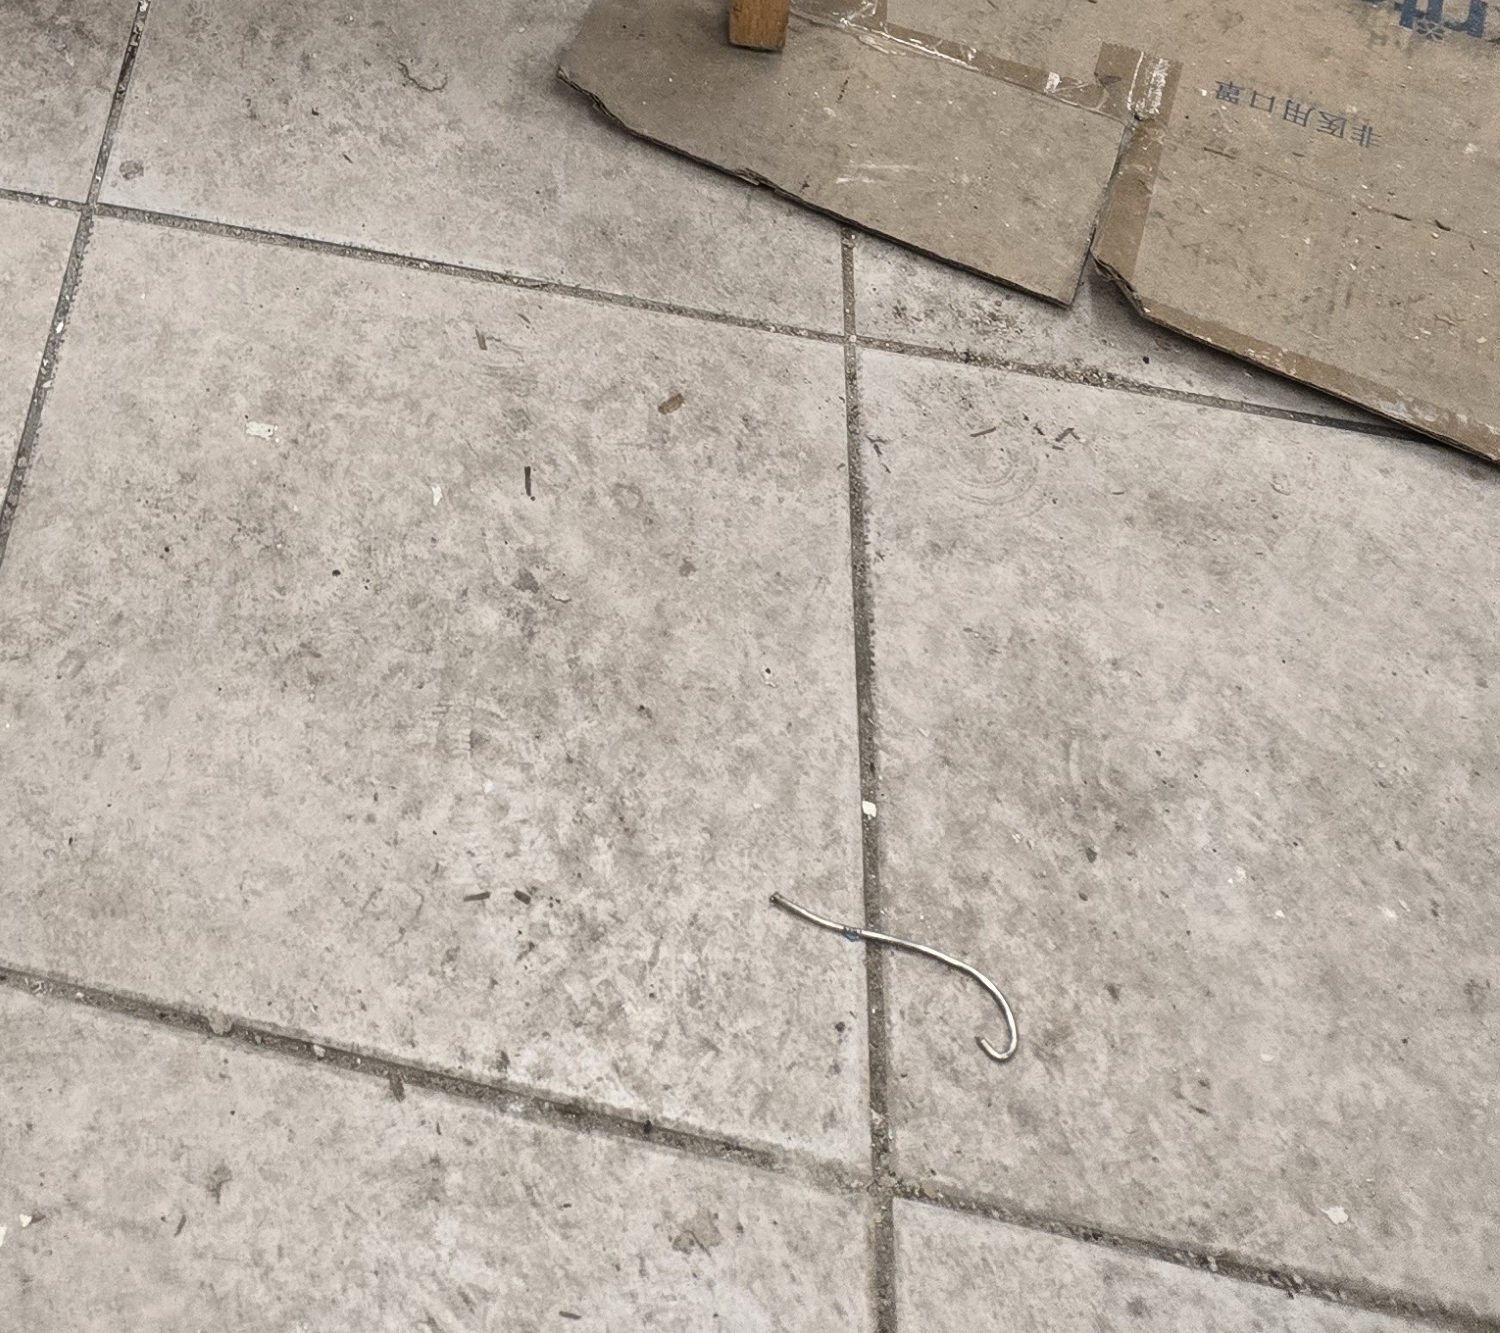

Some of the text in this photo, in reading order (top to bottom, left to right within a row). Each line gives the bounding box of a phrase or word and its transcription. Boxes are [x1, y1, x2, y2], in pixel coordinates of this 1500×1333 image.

[1215, 80, 1383, 150] 非医用口罩
